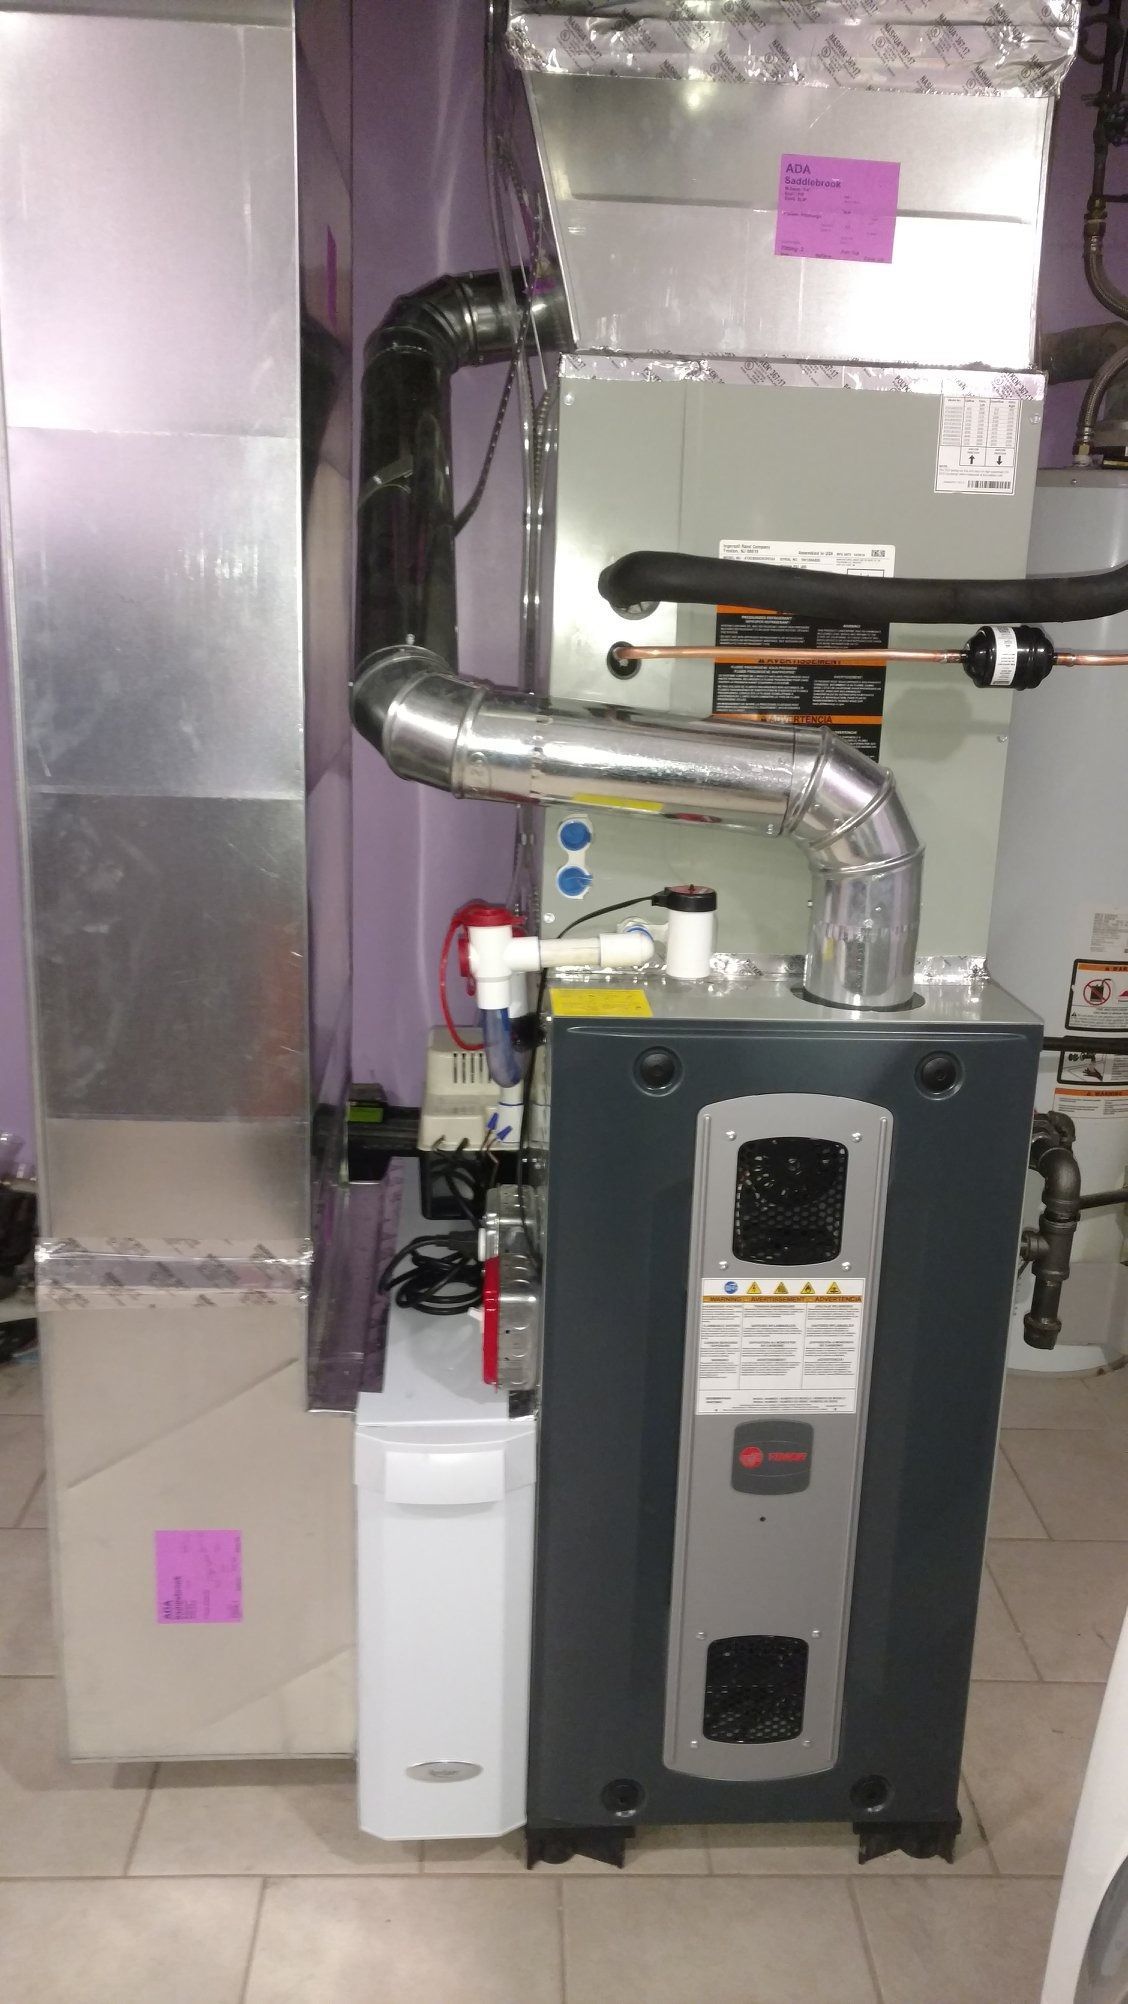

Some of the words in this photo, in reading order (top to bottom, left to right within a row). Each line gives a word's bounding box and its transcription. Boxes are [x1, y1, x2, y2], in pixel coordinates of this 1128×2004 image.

[771, 39, 791, 64] NASHUA
[828, 31, 848, 57] NASHUA
[844, 55, 862, 76] 367-17
[884, 23, 902, 47] NASHUA
[899, 45, 917, 66] 367-17
[717, 48, 738, 74] NASHUA
[785, 163, 812, 175] ADA
[784, 175, 842, 188] Saddlebrook
[768, 369, 787, 387] 367-17
[710, 1295, 741, 1303] WARNING
[751, 1295, 805, 1303] AVERTISSEMENT
